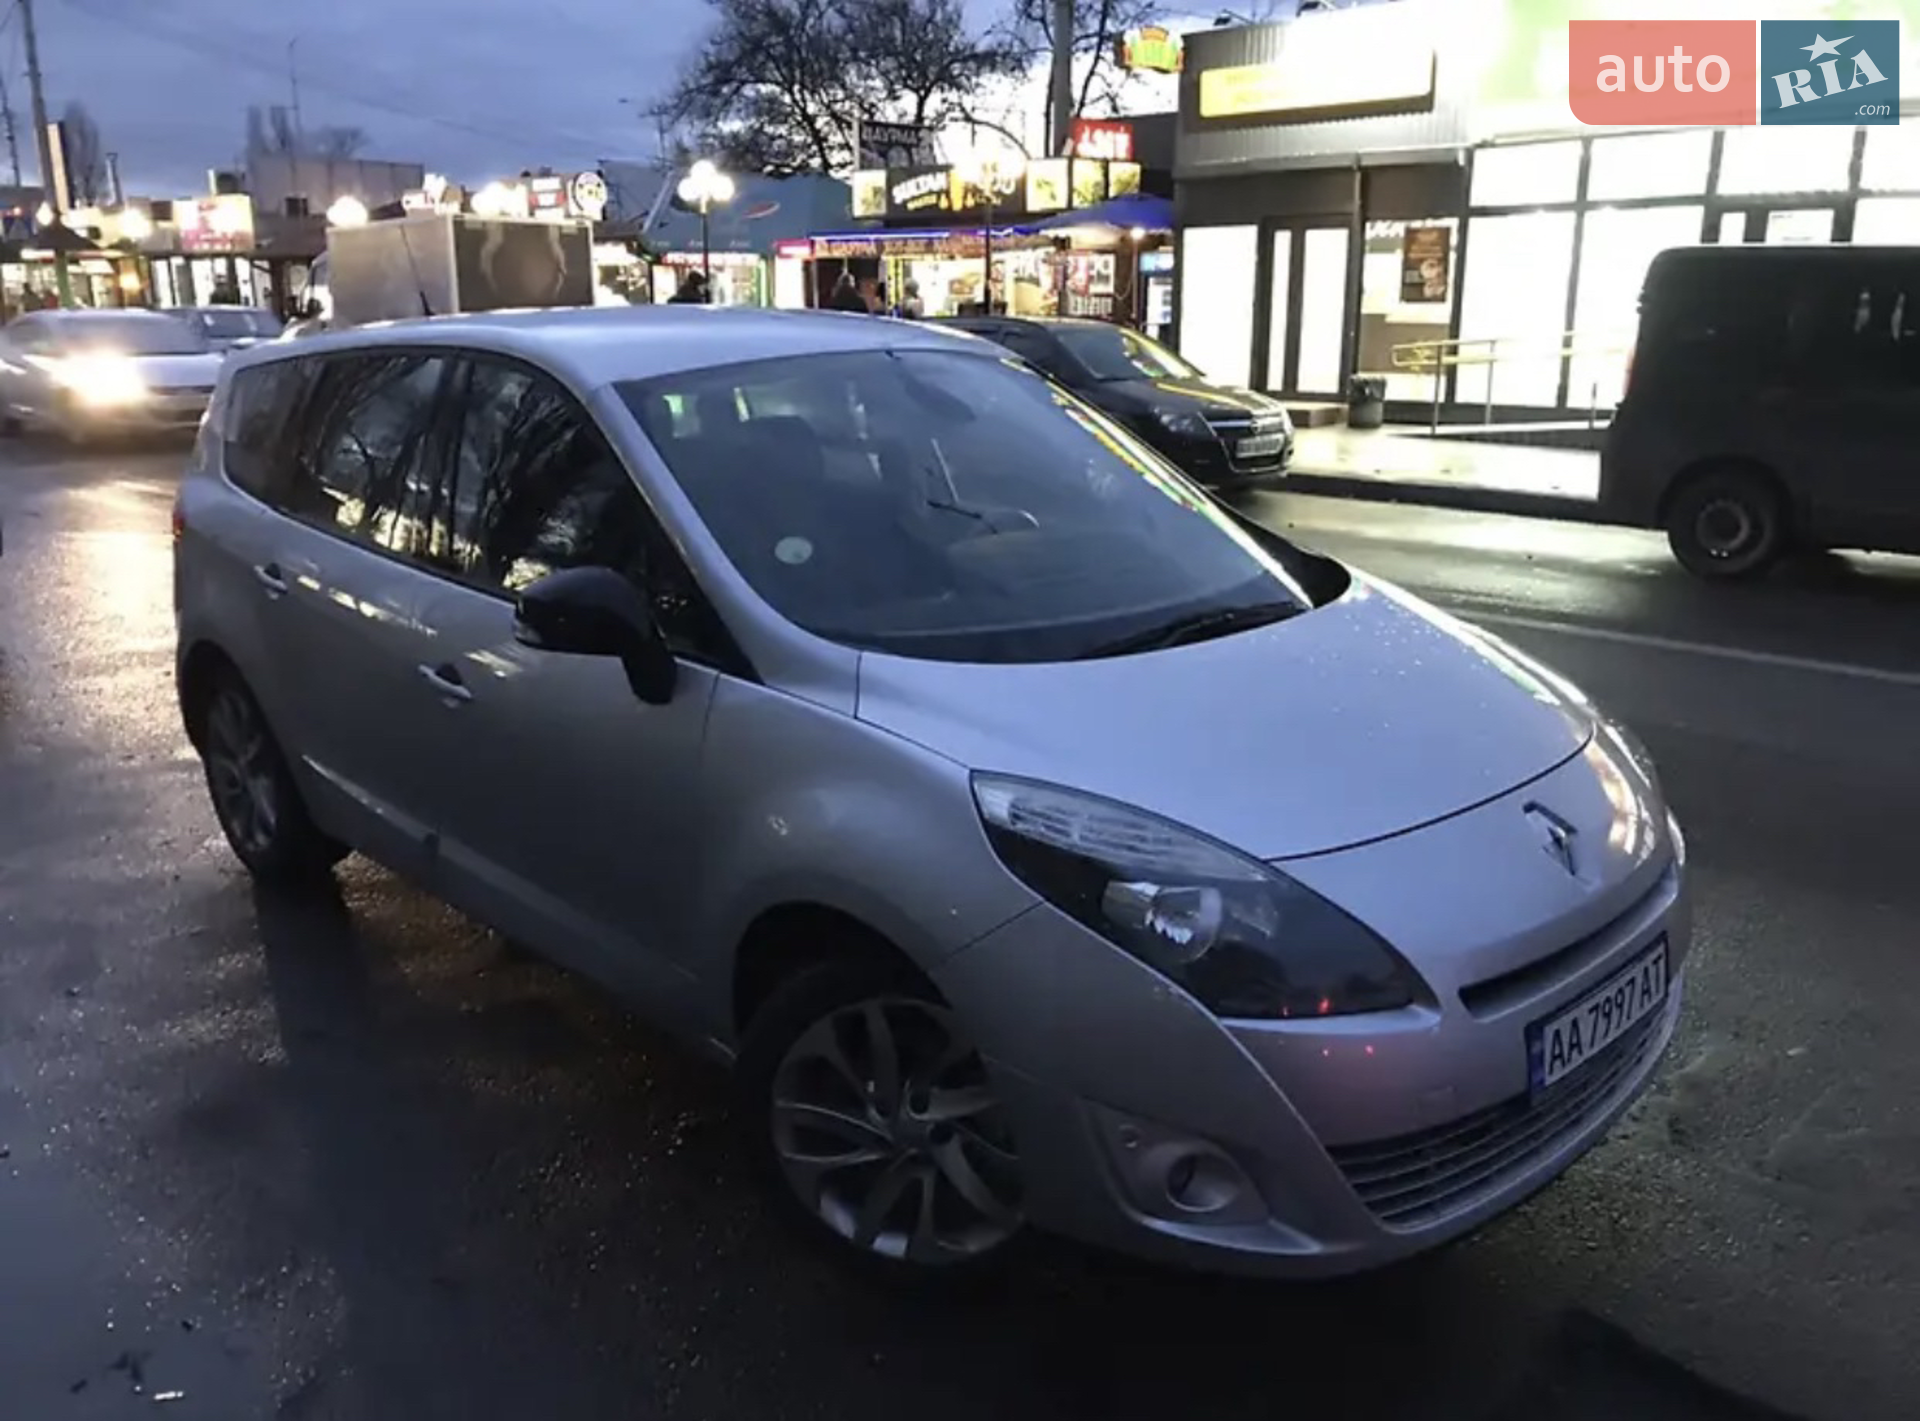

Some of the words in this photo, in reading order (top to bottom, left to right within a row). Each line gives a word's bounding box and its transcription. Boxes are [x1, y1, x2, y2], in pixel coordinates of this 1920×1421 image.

[1548, 1016, 1583, 1075] AA
[1588, 977, 1635, 1048] 7997
[1639, 954, 1663, 1007] AT
